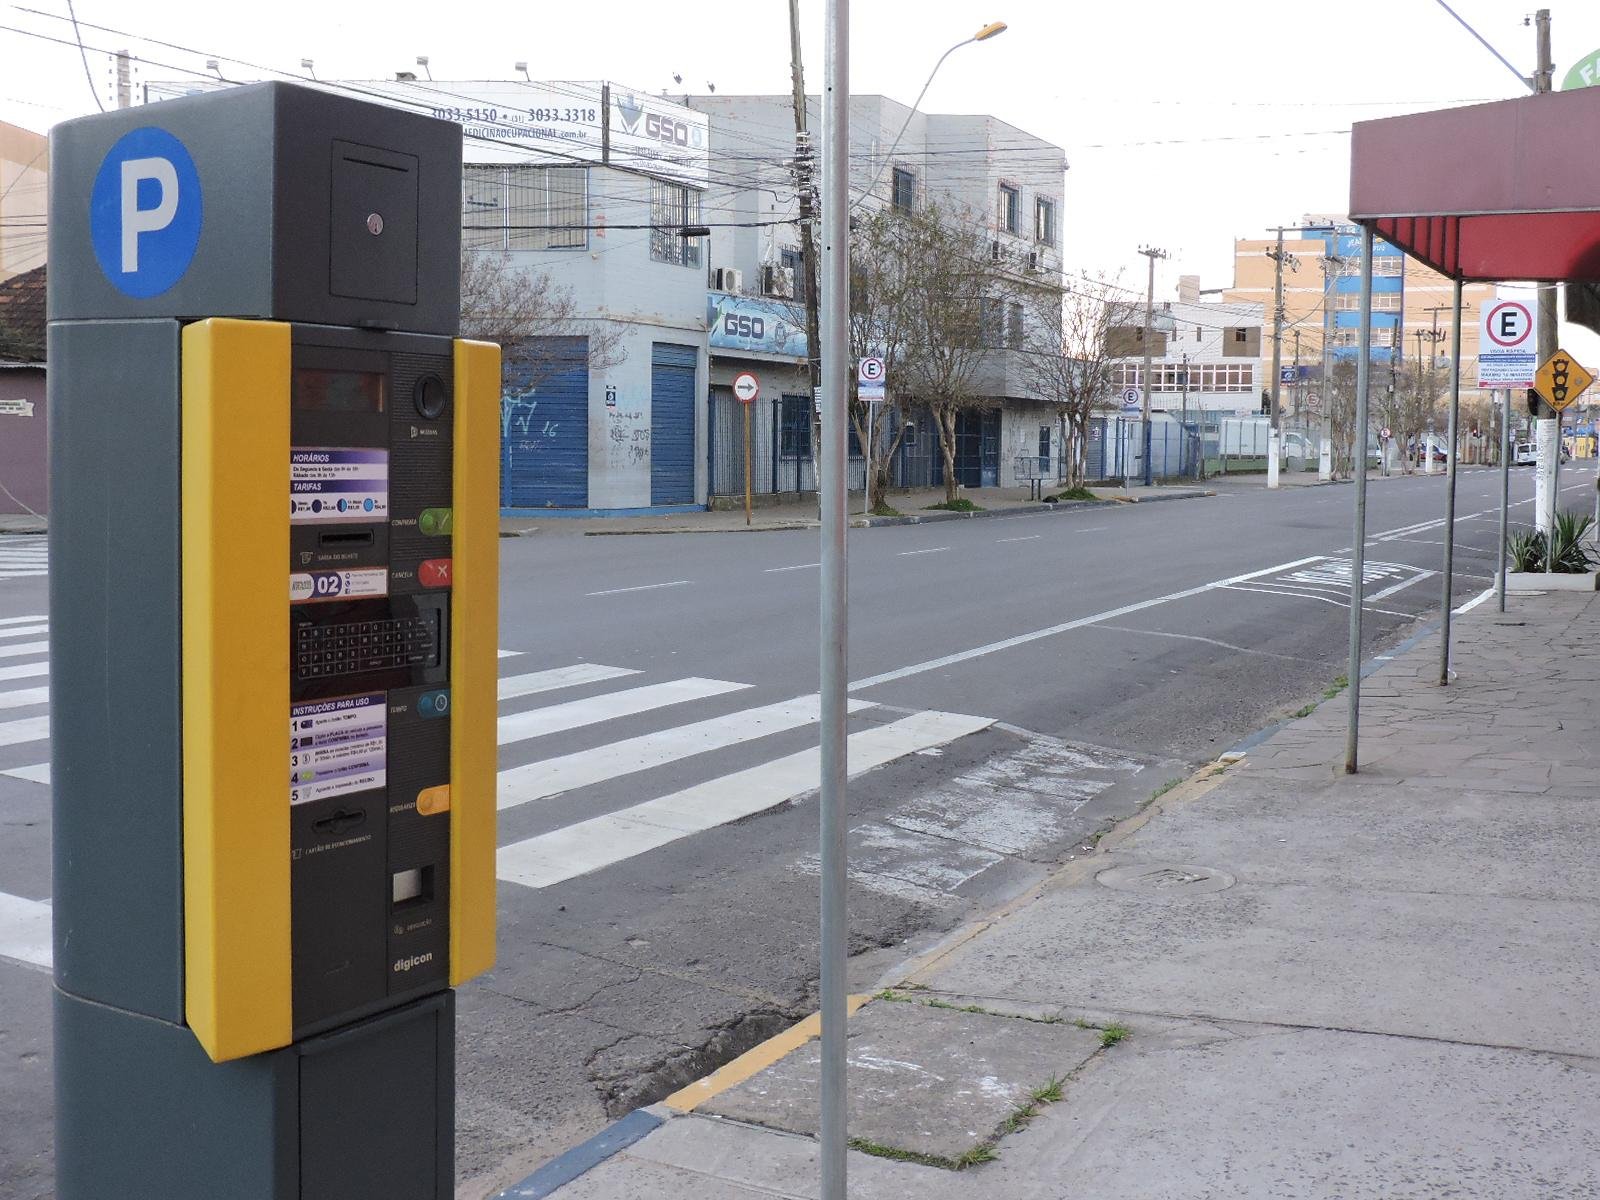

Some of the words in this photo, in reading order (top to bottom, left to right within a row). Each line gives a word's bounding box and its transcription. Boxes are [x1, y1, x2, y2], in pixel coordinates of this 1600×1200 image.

[528, 108, 596, 122] 3033.3318
[645, 113, 688, 147] GSO
[121, 156, 179, 273] P
[724, 312, 765, 340] GSO
[1501, 312, 1517, 336] E
[868, 363, 876, 375] E
[293, 452, 330, 462] HORÁRIOS
[294, 482, 322, 491] TARIFAS
[317, 575, 339, 594] 02
[293, 701, 336, 716] INSTRUÇÕES
[336, 699, 355, 710] PARA
[355, 697, 370, 706] USO
[292, 720, 298, 732] 1
[291, 738, 299, 750] 2
[292, 755, 299, 766] 3
[291, 772, 299, 784] 4
[292, 790, 299, 801] 5
[393, 952, 433, 972] digicon
